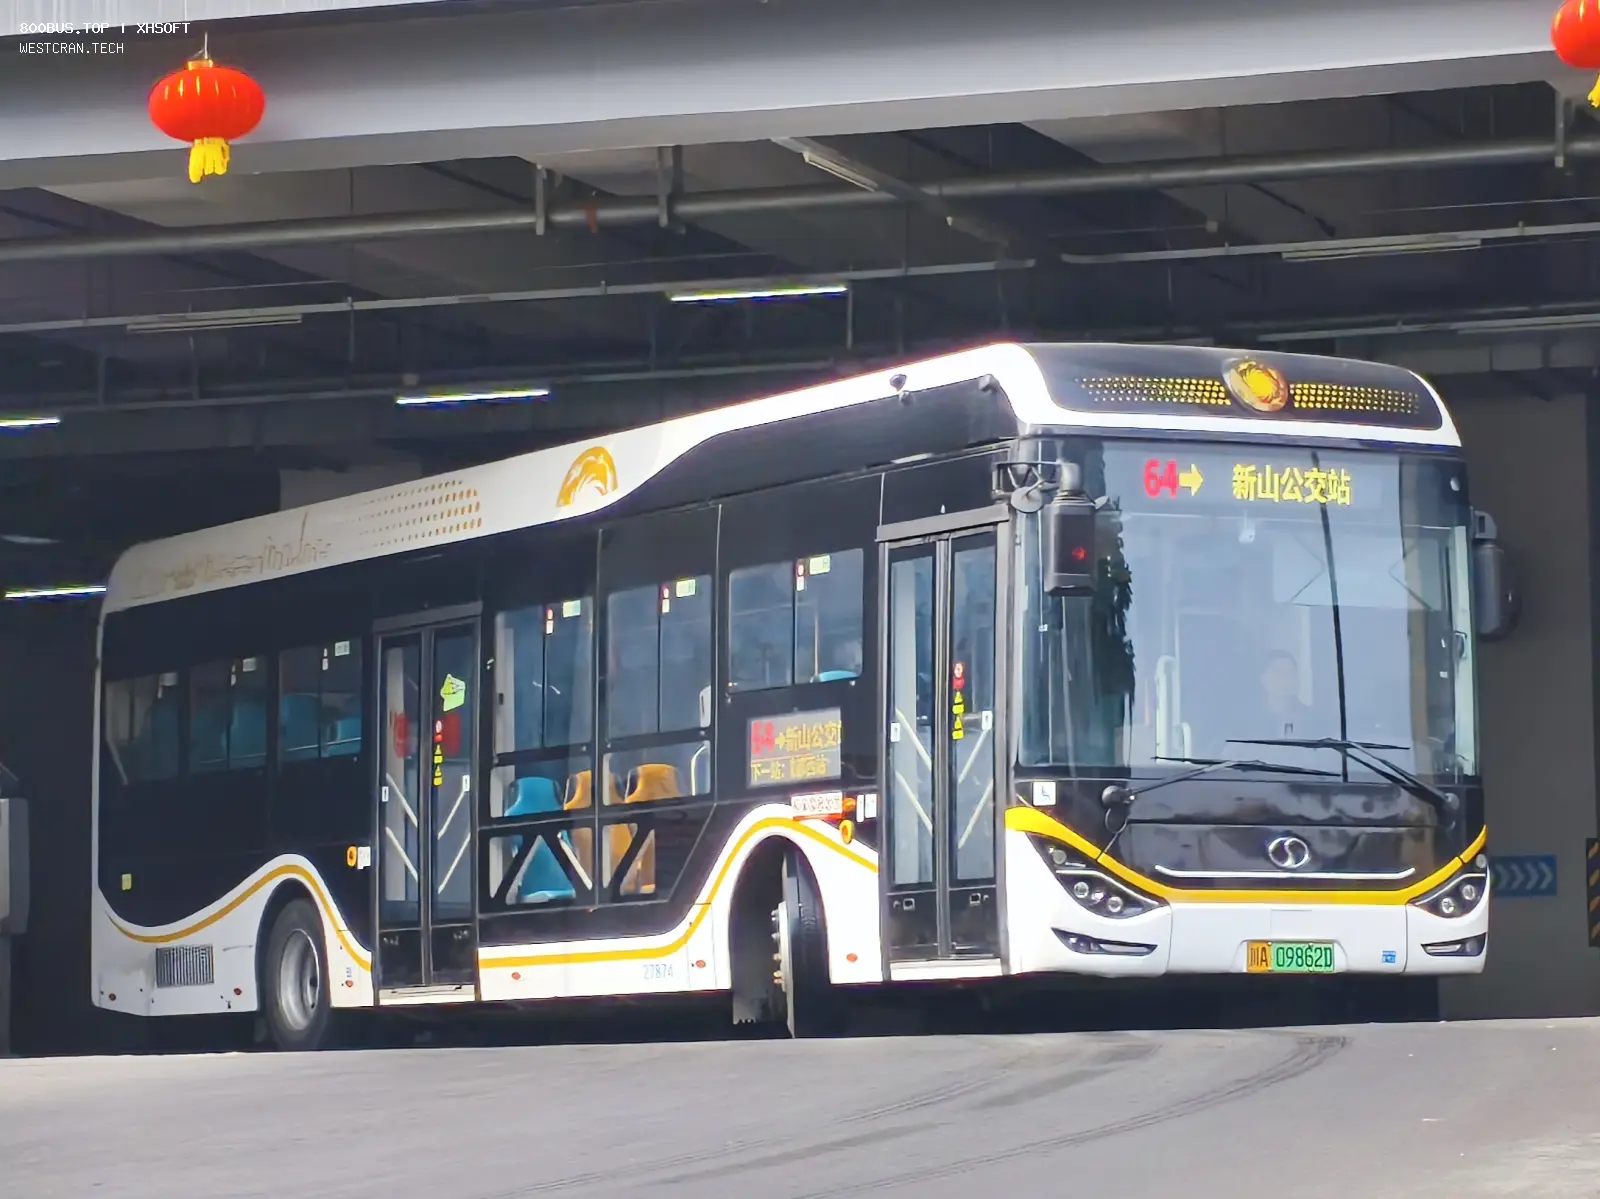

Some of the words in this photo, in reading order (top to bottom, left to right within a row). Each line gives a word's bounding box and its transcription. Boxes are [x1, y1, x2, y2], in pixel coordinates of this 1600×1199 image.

[1143, 458, 1178, 499] 64
[1232, 463, 1352, 506] 新山公交站
